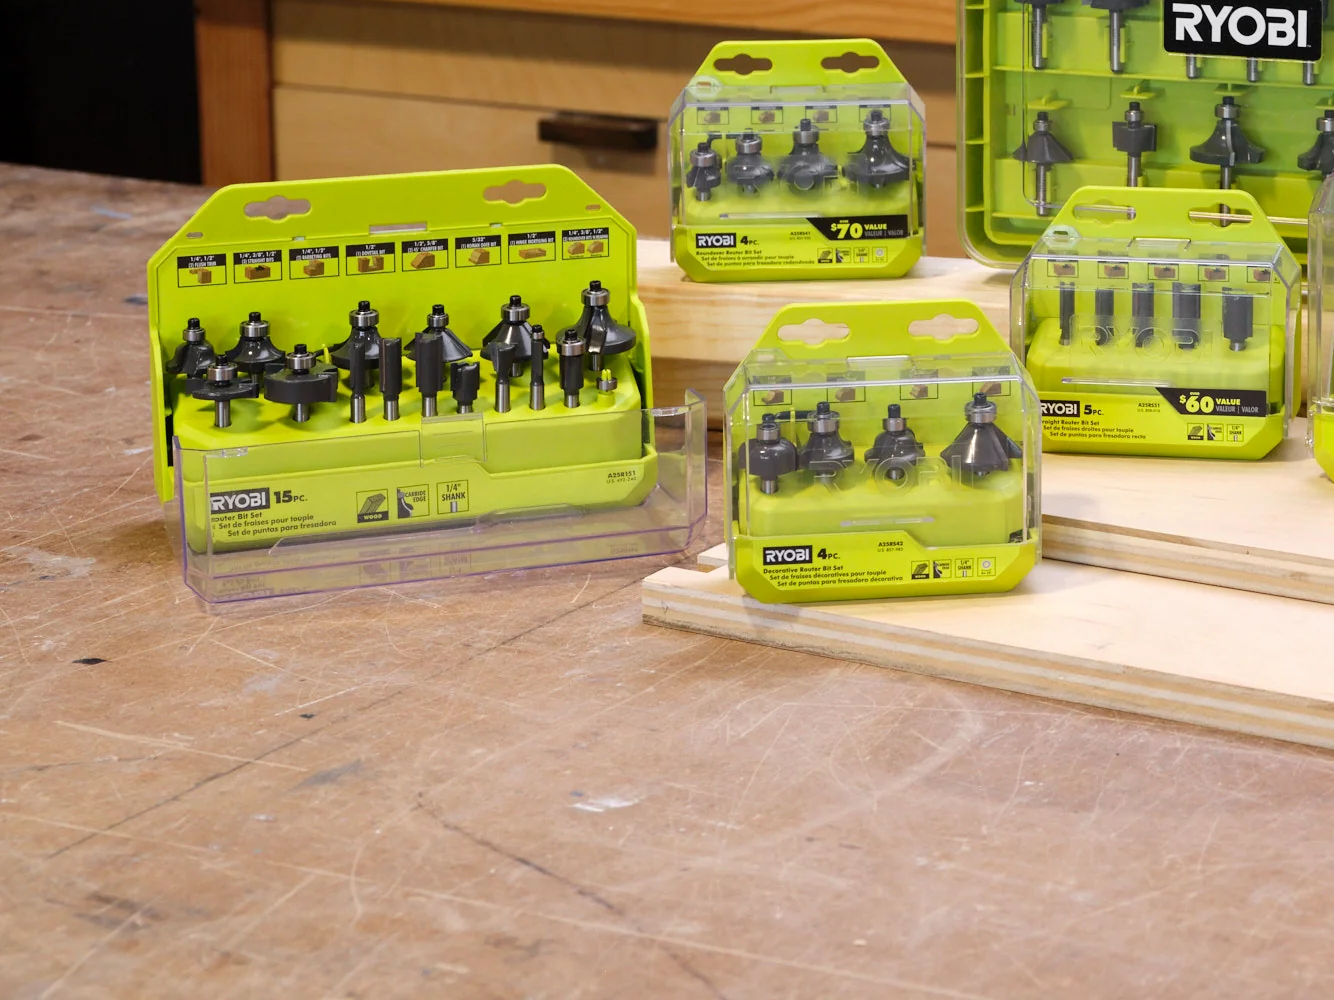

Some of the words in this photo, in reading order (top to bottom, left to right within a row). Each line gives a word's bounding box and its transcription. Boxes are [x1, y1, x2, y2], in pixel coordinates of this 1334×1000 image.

[1172, 3, 1308, 48] RYOBI
[831, 223, 863, 238] $70
[698, 235, 734, 247] RYOBI
[740, 236, 748, 245] 4
[1041, 403, 1077, 415] RYOBI
[1084, 405, 1092, 415] 5
[1180, 395, 1214, 413] $60
[446, 484, 461, 492] 1/4"
[211, 491, 266, 511] RYOBI
[274, 490, 293, 504] 15
[442, 492, 466, 501] SHANK
[244, 519, 269, 527] fraises
[290, 514, 314, 523] toupie
[765, 548, 809, 562] RYOBI
[817, 548, 827, 560] 4
